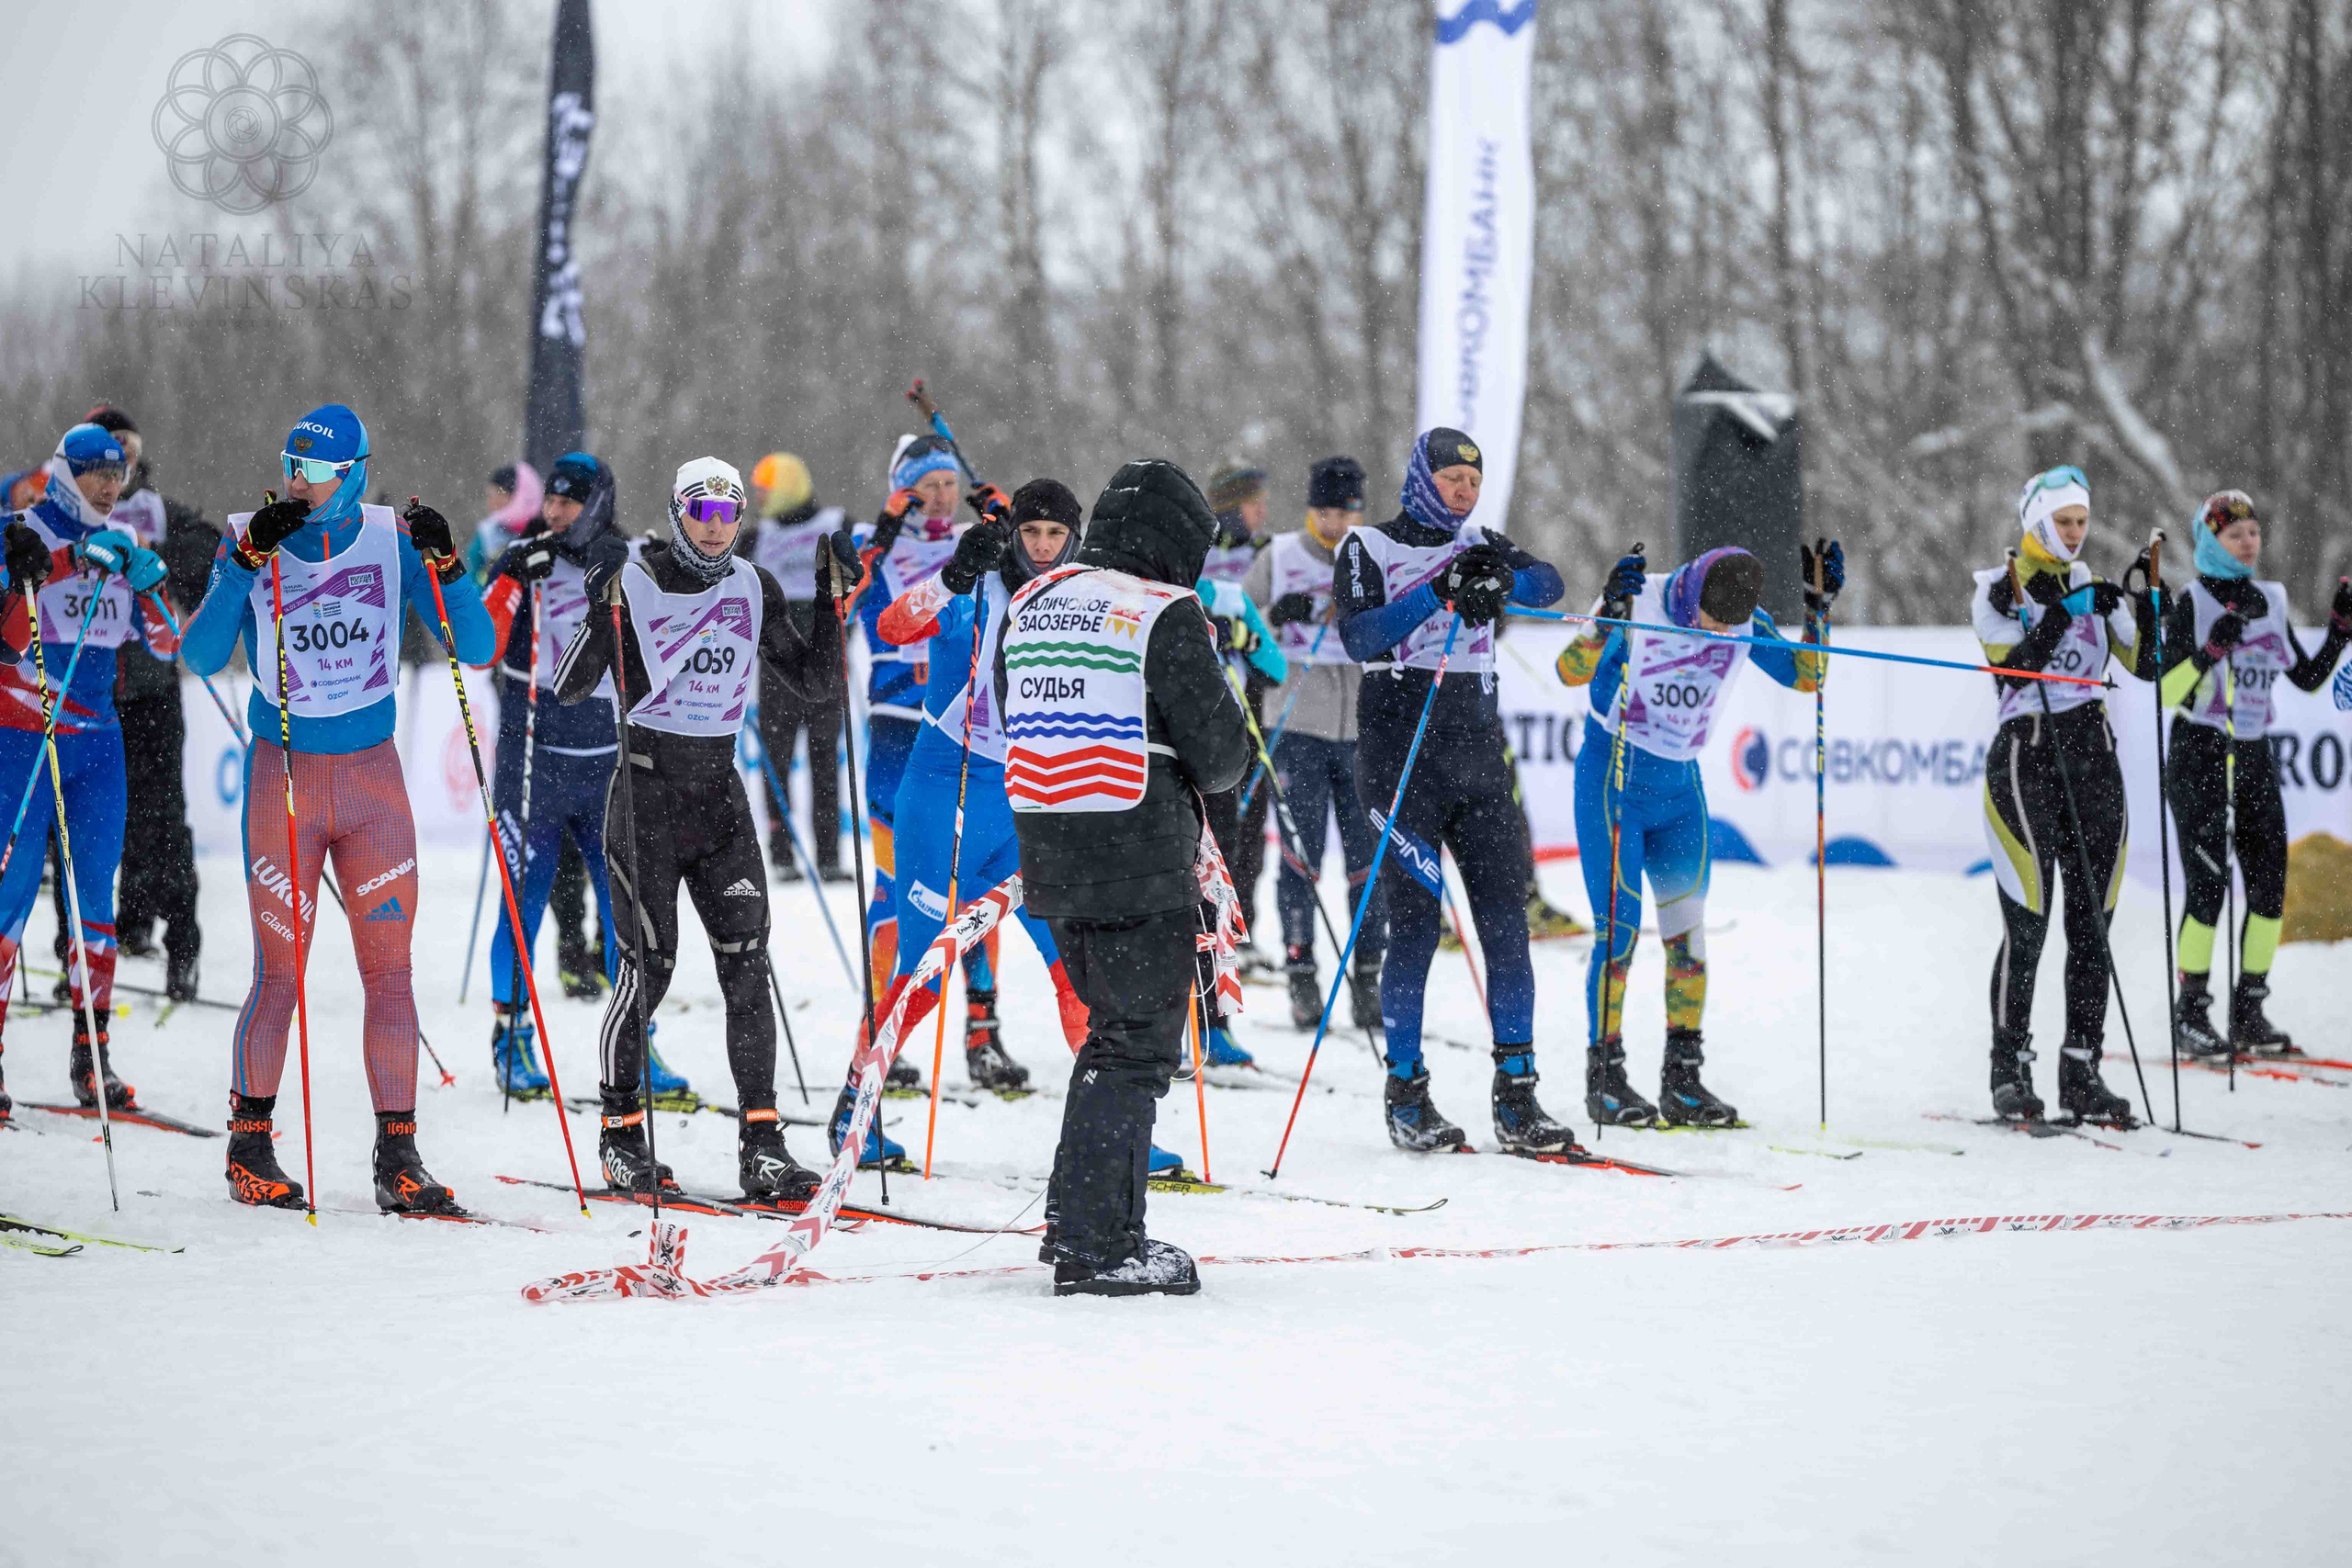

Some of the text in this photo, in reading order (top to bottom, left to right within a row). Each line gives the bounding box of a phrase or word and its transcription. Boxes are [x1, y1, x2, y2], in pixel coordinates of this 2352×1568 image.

[1348, 541, 1364, 598] SPINE
[64, 593, 119, 620] 3011
[1025, 597, 1112, 614] АЛИЧСКОЕ
[289, 617, 369, 652] 3004
[1019, 614, 1103, 633] ЗАОЗЕРЬЕ
[317, 658, 332, 671] 14
[318, 673, 362, 687] СОВКОМБАНК
[448, 657, 466, 700] LEKI
[689, 680, 703, 693] 14
[1021, 677, 1085, 702] СУДЬЯ
[327, 690, 349, 701] OZON
[40, 686, 56, 745] WAY
[279, 697, 289, 742] LEKI
[687, 714, 710, 722] OZON
[1777, 739, 1986, 784] СОВКОМБА
[959, 761, 968, 807] CHAMPION
[1368, 807, 1442, 885] SPINE
[251, 855, 316, 924] LUKOIL
[356, 857, 416, 897] SCANIA
[723, 888, 761, 897] adidas
[365, 912, 408, 921] adidas
[777, 1200, 808, 1211] ROSSIGNO
